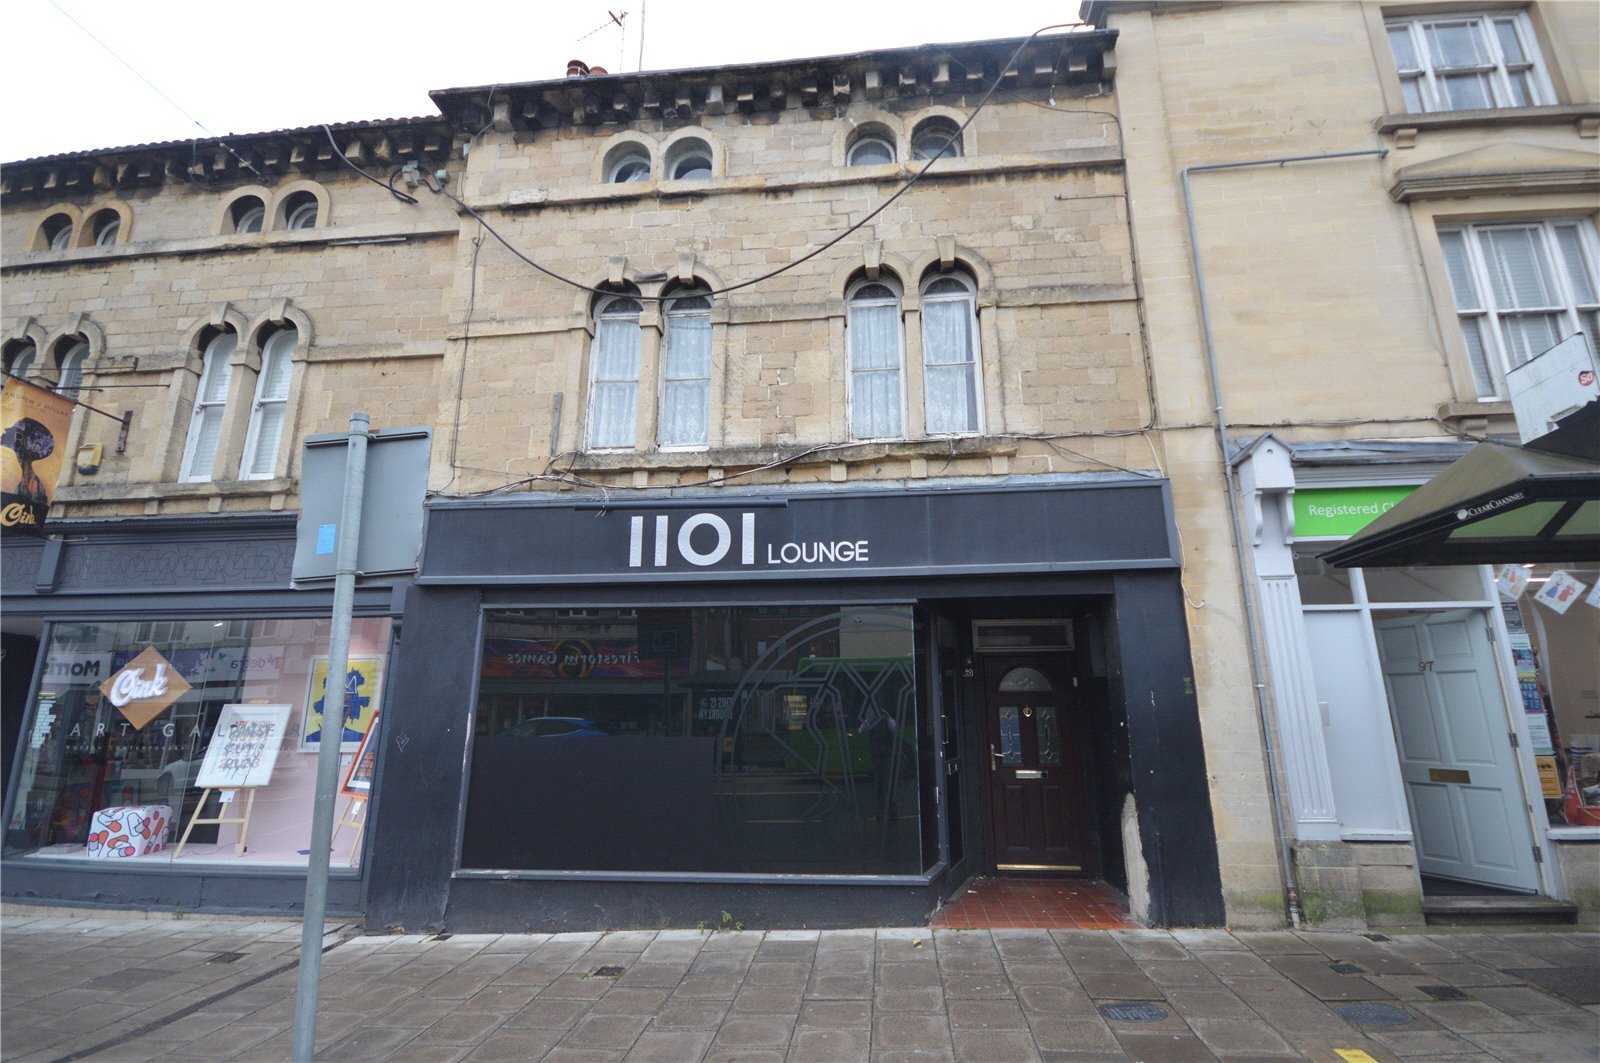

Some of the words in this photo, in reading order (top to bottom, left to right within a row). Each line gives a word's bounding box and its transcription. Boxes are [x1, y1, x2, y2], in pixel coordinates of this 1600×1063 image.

[1308, 503, 1379, 518] Registered
[629, 512, 755, 567] 1101
[768, 540, 869, 564] LOUNGE
[1418, 661, 1434, 672] 97
[111, 663, 169, 707] Oink
[69, 722, 131, 737] ART
